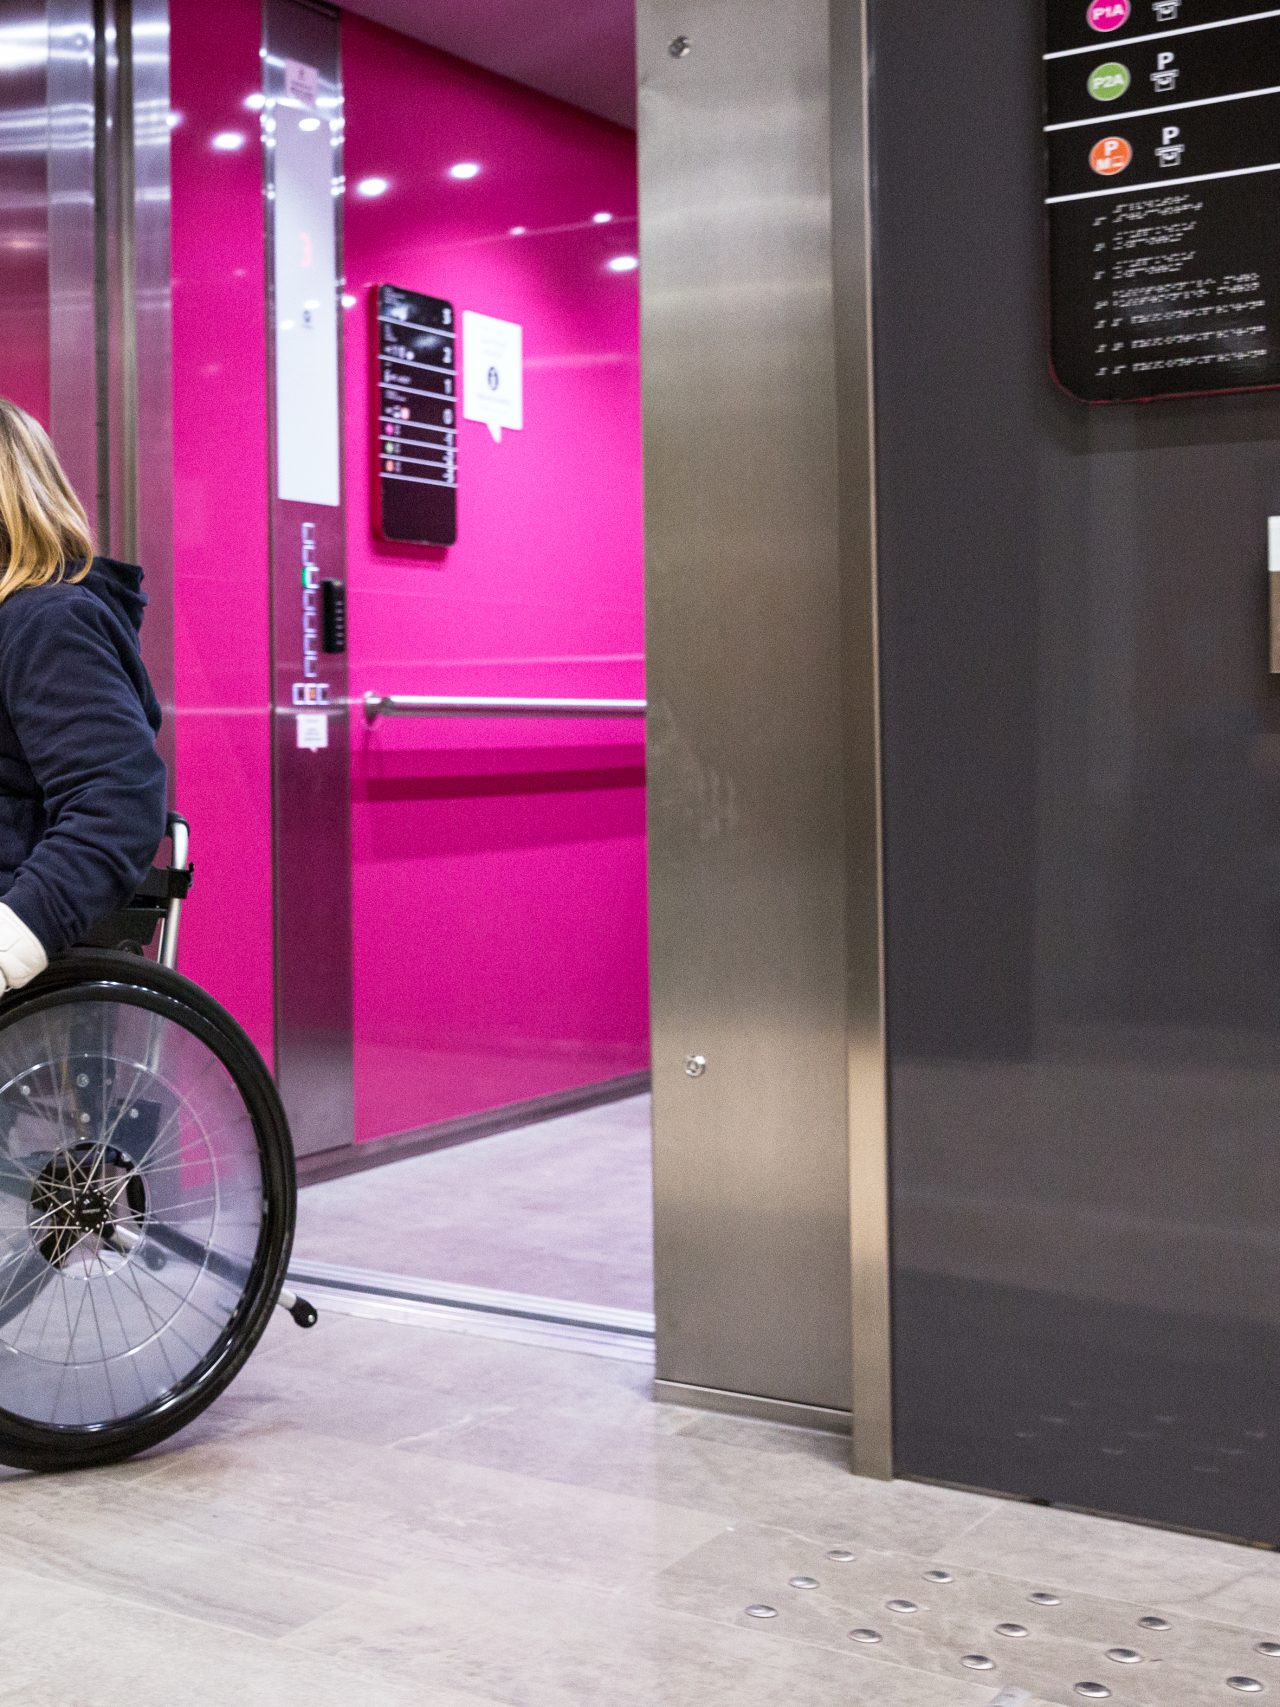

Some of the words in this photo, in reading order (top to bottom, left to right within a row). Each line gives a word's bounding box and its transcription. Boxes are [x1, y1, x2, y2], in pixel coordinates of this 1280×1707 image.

[1092, 4, 1125, 20] P1A
[1157, 52, 1175, 70] P
[1093, 73, 1125, 90] P2A
[1162, 126, 1180, 145] P
[1104, 140, 1119, 156] P
